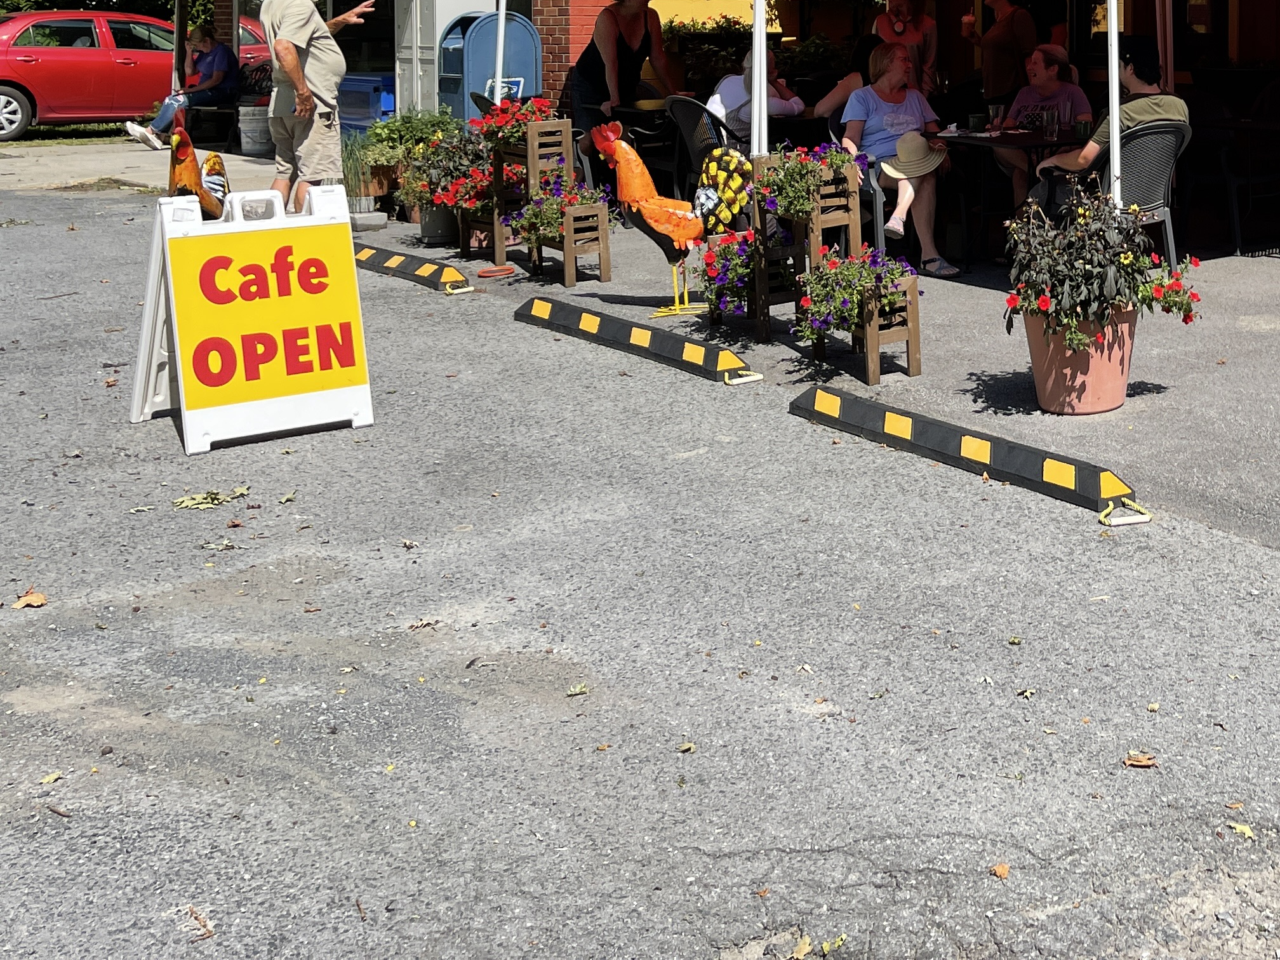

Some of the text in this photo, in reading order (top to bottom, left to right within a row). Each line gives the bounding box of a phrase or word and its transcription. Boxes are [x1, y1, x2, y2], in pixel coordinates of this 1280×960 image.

[1019, 104, 1039, 113] OLD
[199, 245, 330, 305] Cafe
[192, 321, 356, 388] OPEN
